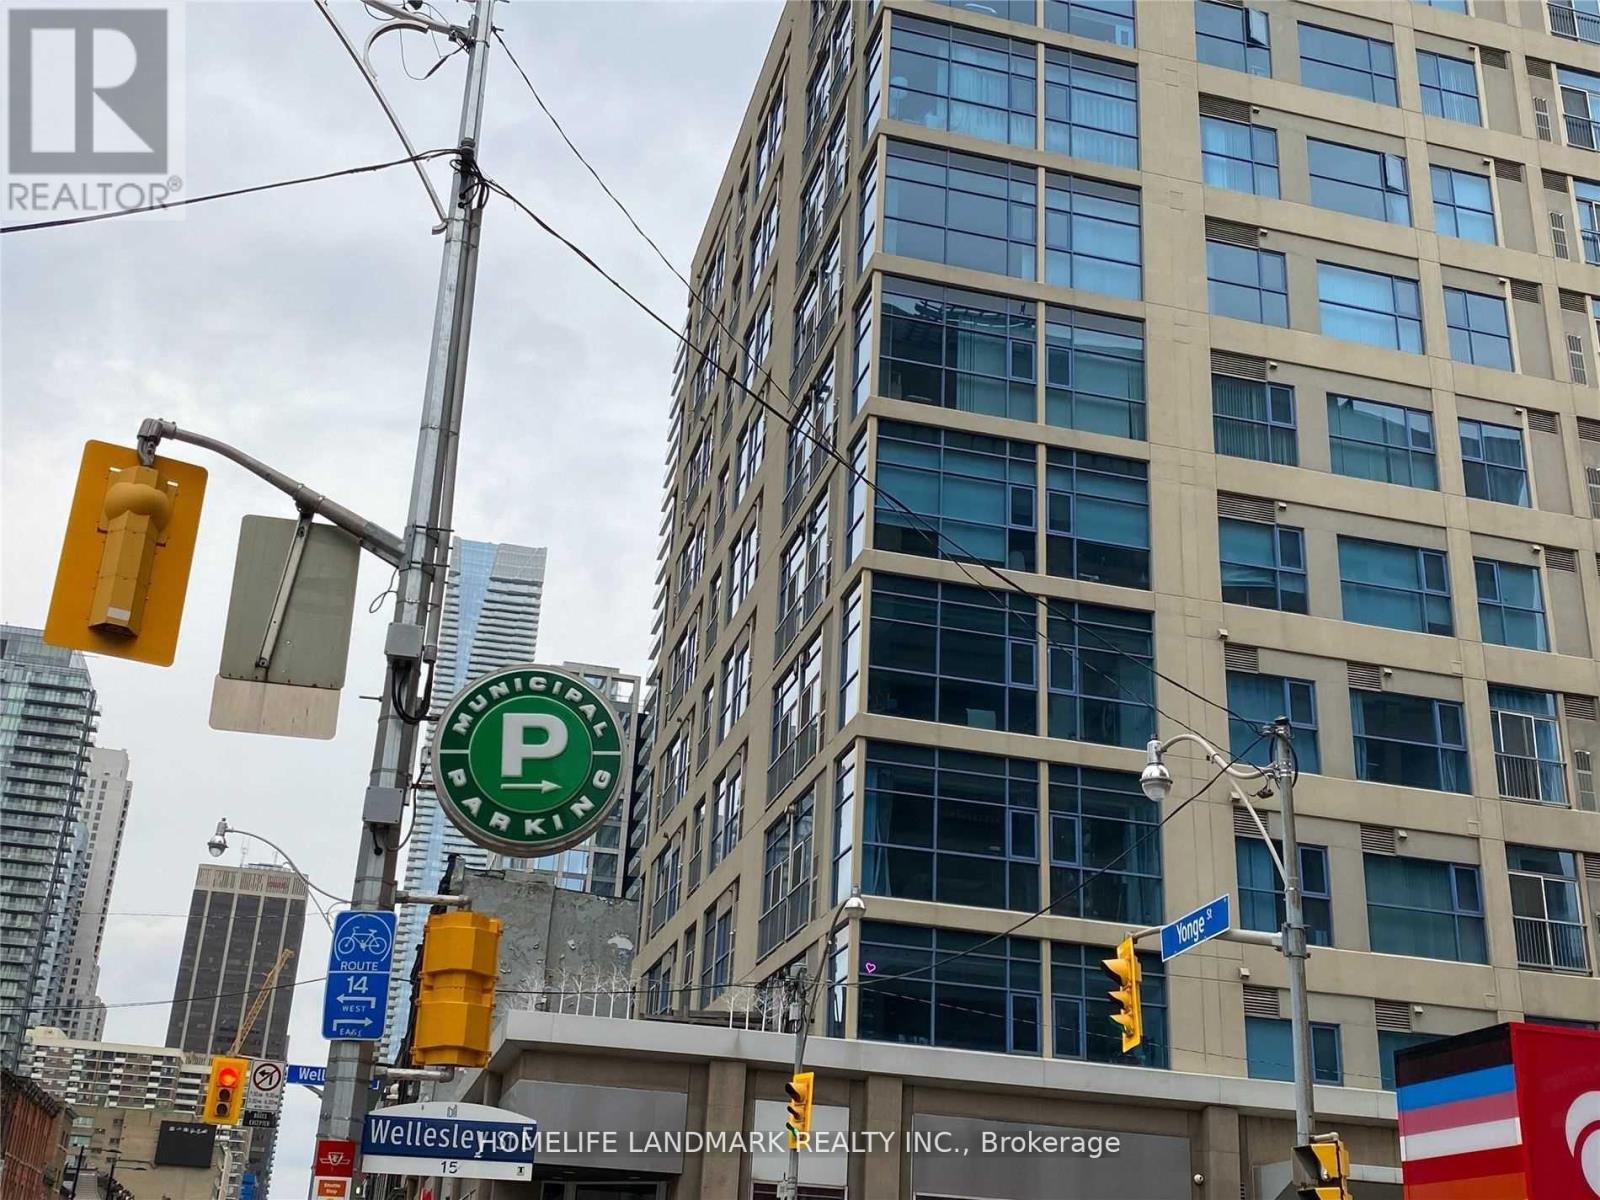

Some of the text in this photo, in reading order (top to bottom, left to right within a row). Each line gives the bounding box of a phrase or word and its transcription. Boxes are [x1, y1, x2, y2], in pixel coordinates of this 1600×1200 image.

[452, 676, 608, 737] MUNICIPAL
[501, 712, 568, 778] P
[448, 768, 612, 836] PARKING
[1176, 907, 1213, 944] Yonge St
[340, 961, 379, 971] ROUTE
[347, 976, 369, 994] 14
[342, 1004, 367, 1013] WEST
[371, 1118, 489, 1158] Wellesley
[440, 1160, 458, 1174] 15
